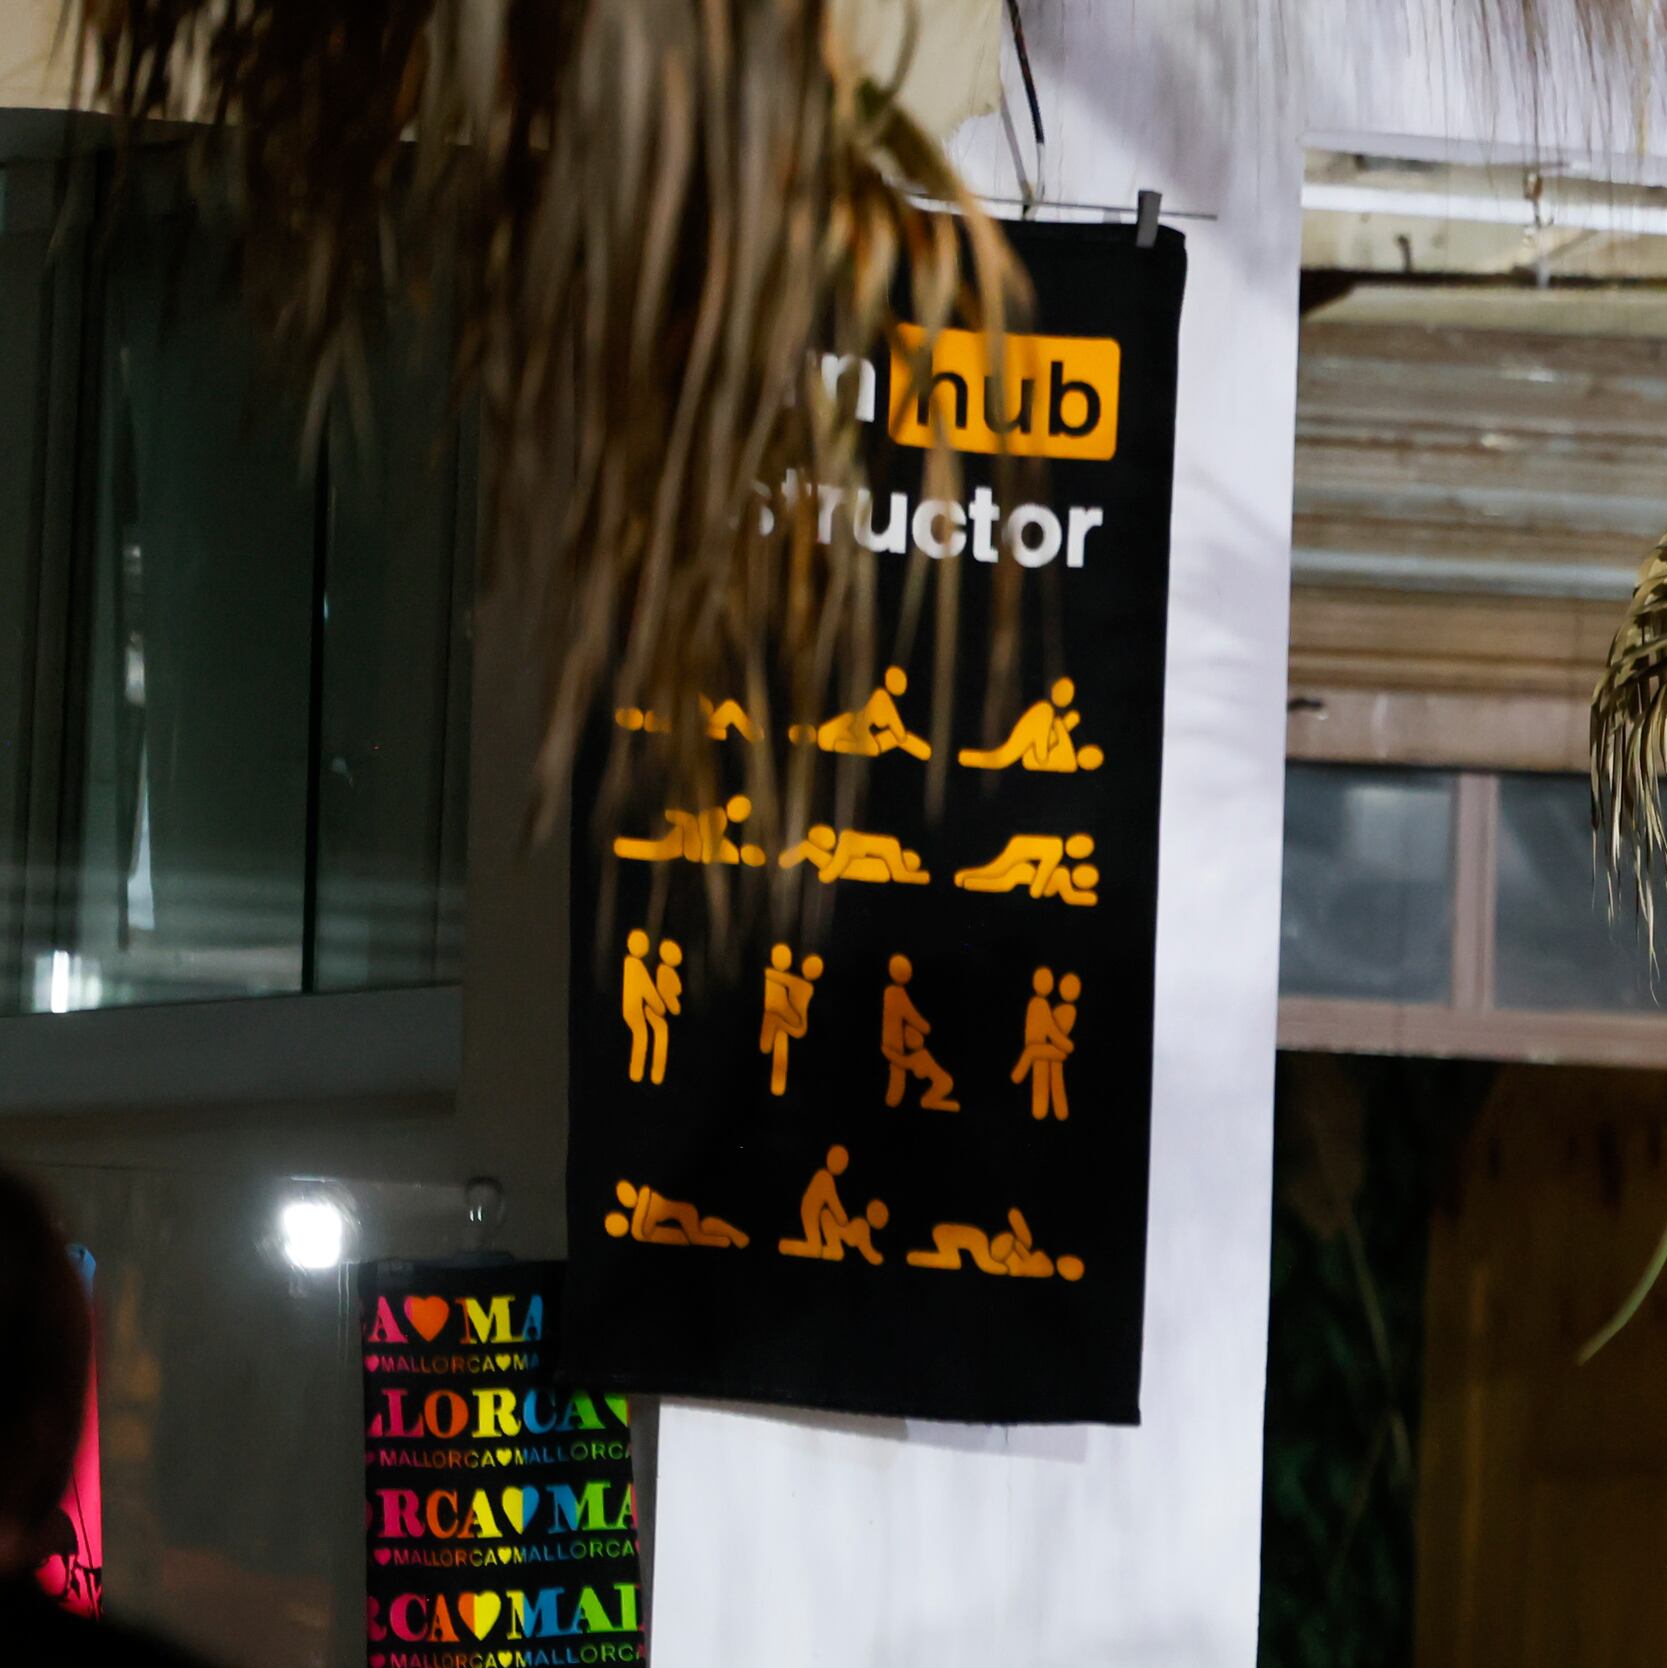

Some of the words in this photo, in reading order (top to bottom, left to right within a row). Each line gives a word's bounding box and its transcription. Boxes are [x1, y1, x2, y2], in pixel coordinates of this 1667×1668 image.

[916, 352, 1102, 437] hub
[381, 1354, 496, 1375] MALLORCA
[379, 1448, 496, 1469] MALLORCA
[366, 1487, 504, 1540] RCA
[393, 1546, 498, 1567] MALLORCA
[512, 1539, 636, 1563] MALLORCA
